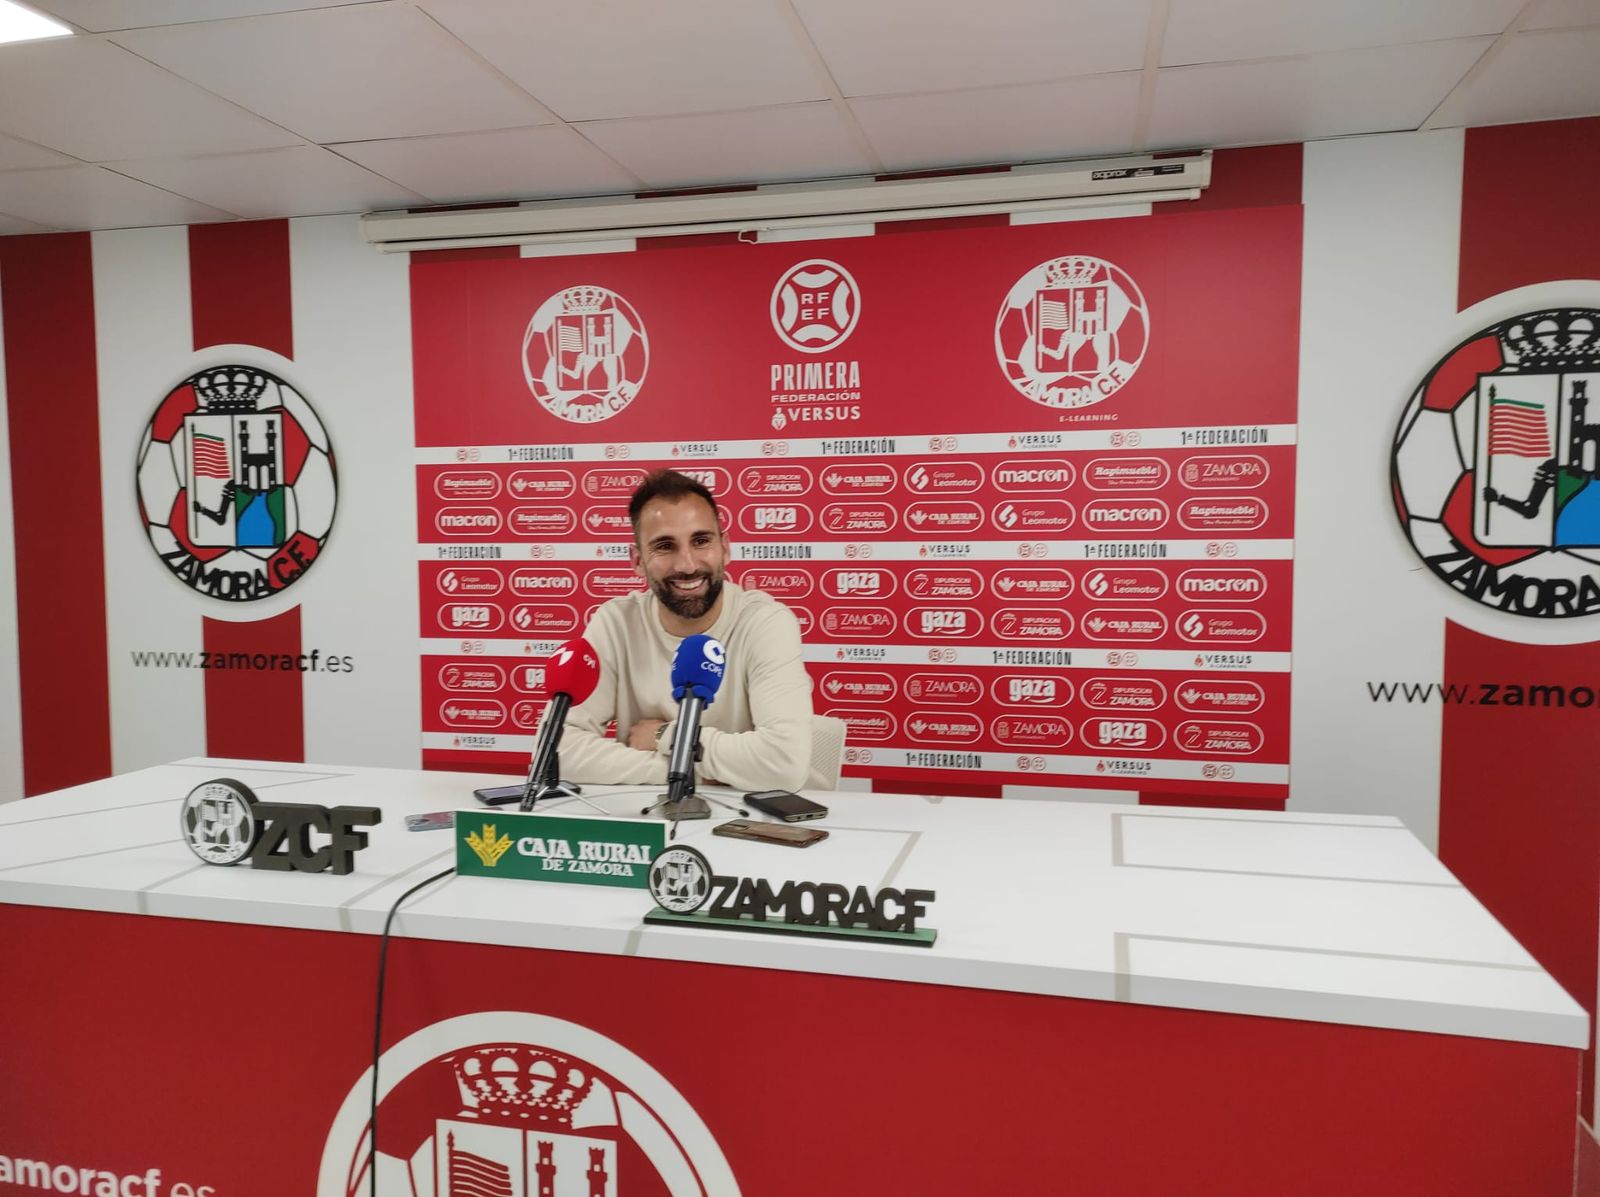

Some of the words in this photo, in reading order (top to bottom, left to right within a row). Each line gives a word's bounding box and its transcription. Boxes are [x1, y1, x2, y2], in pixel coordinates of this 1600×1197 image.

[801, 292, 830, 305] RF
[801, 308, 830, 321] EF
[770, 361, 861, 391] PRIMERA
[770, 390, 861, 403] FEDERACIÓN
[788, 406, 861, 421] VERSUS
[1059, 414, 1119, 422] E-LEARNING
[1018, 435, 1062, 444] VERSUS
[1195, 427, 1268, 444] FEDERACIÓN
[681, 444, 718, 453] VERSUS
[833, 438, 896, 454] FEDERACIÓN
[999, 469, 1069, 483] macron
[1202, 462, 1262, 478] ZAMORA
[764, 483, 803, 492] ZAMORA
[441, 514, 497, 527] macron
[755, 508, 797, 529] gaza
[1090, 508, 1162, 522] macron
[846, 520, 887, 530] ZAMORA
[606, 546, 630, 554] VERS
[752, 544, 812, 559] FEDERACIÓN
[928, 544, 971, 553] VERSUS
[1098, 542, 1167, 558] FEDERACIÓN
[160, 541, 269, 600] ZAMORA
[514, 576, 572, 588] macron
[759, 576, 807, 587] ZAMORA
[837, 573, 880, 594] gaza
[1184, 578, 1259, 592] macron
[931, 587, 974, 595] ZAMORA
[452, 607, 490, 627] gaza
[840, 614, 890, 626] ZAMORA
[921, 611, 966, 634] gaza
[1019, 627, 1064, 636] ZAMORA
[533, 643, 556, 651] VERS
[846, 648, 886, 657] VERSUS
[131, 649, 354, 673] www.zamoracf.es
[1006, 650, 1072, 666] FEDERACIÓN
[1204, 654, 1252, 664] VERSUS
[461, 680, 497, 688] ZAMORA
[525, 668, 546, 688] ga
[925, 680, 977, 693] ZAMORA
[1009, 679, 1056, 702] gaza
[1110, 697, 1156, 706] ZAMORA
[1366, 681, 1600, 708] www.zamo
[1013, 722, 1066, 736] ZAMORA
[1099, 722, 1148, 744] gaza
[1204, 740, 1252, 750] ZAMORA
[918, 753, 982, 769] FEDERACIÓN
[1106, 760, 1152, 771] VERSUS
[251, 802, 382, 876] ZCF
[516, 837, 574, 860] CAJA
[541, 858, 560, 871] DE
[567, 860, 634, 877] ZAMORA
[708, 875, 936, 934] ZAMORACF
